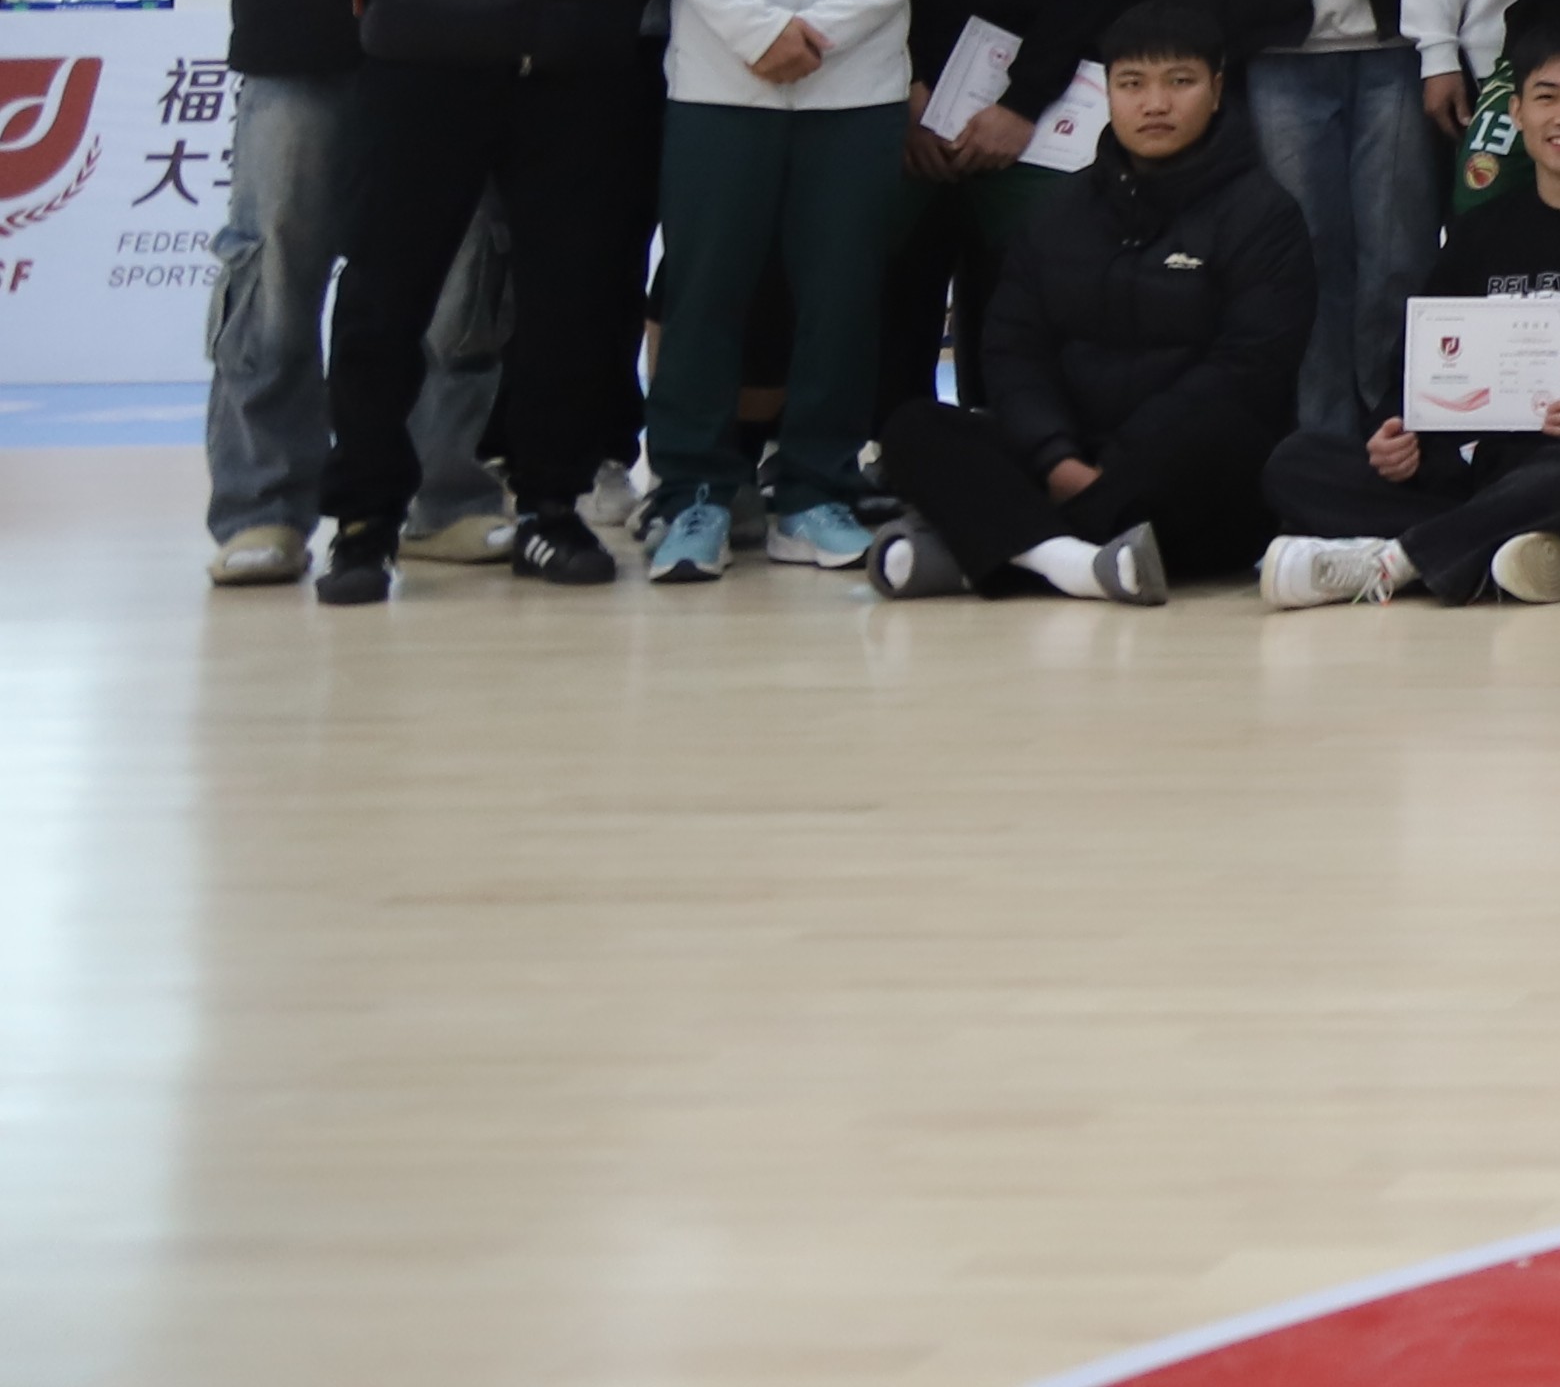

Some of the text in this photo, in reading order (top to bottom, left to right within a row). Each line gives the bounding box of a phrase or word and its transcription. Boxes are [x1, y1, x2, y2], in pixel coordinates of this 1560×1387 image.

[157, 57, 245, 125] 福
[1469, 110, 1519, 156] 13
[117, 232, 213, 254] FEDER
[108, 264, 221, 288] SPORTS
